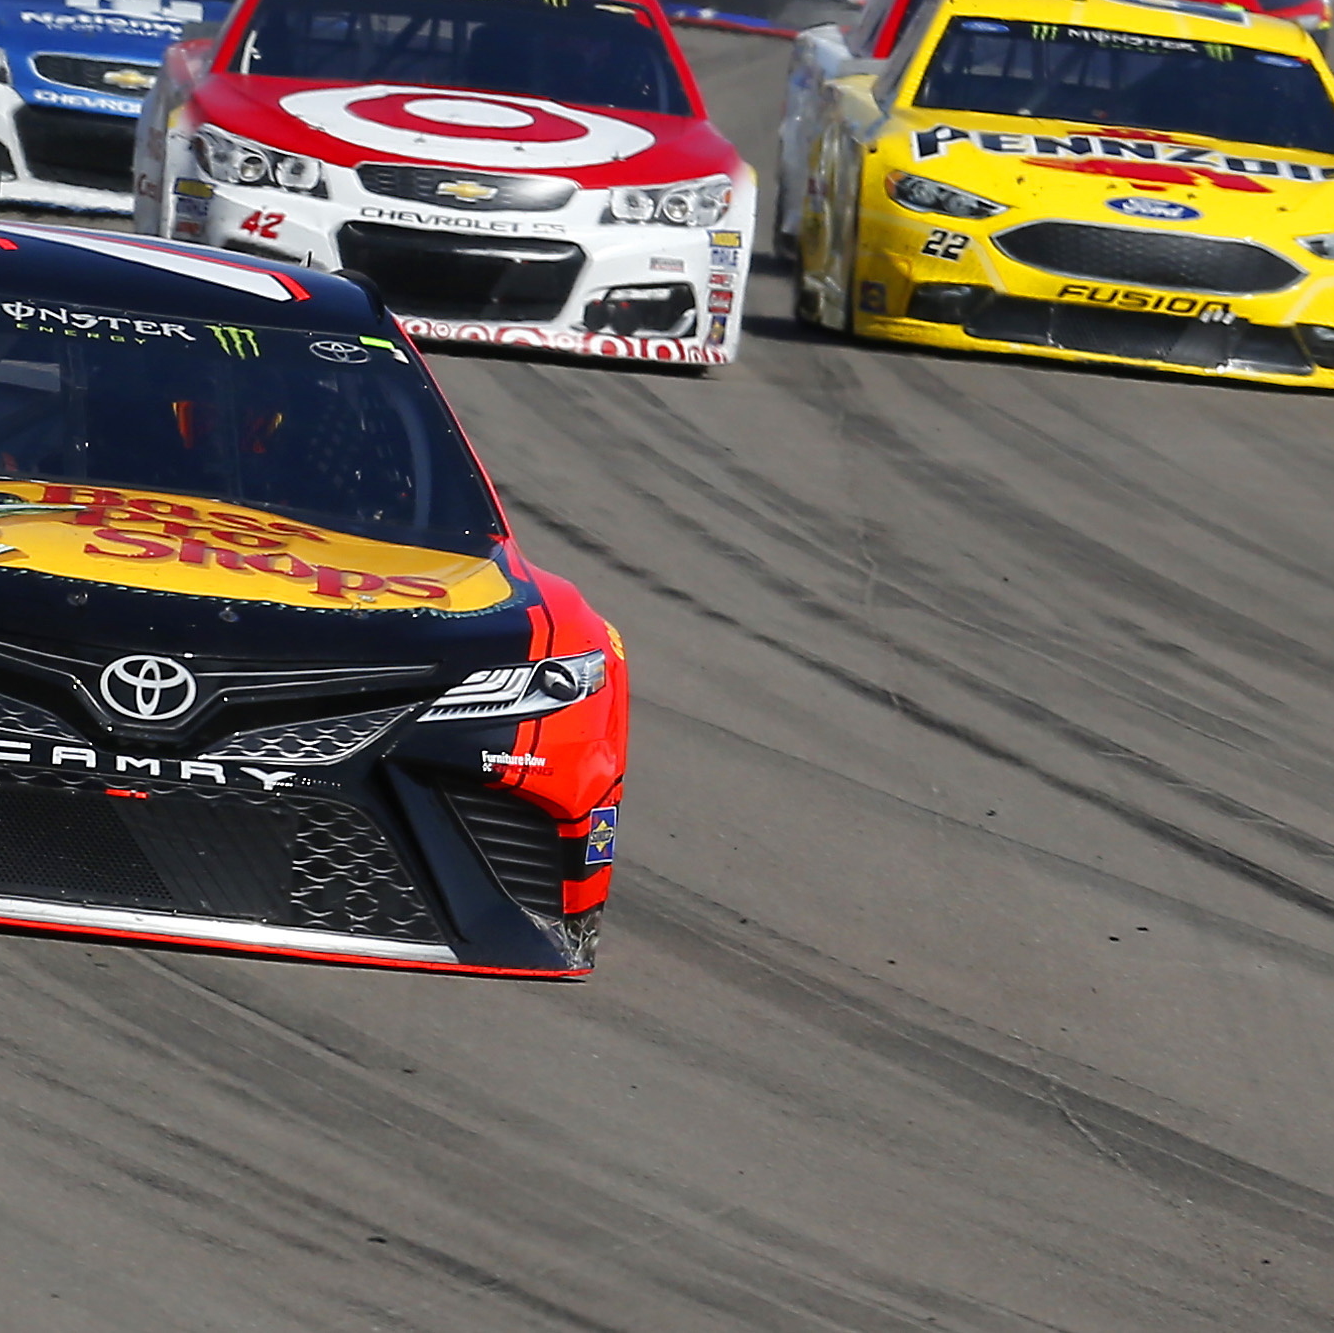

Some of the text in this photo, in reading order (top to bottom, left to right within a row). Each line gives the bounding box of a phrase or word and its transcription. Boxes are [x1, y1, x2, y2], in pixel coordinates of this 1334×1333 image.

[1068, 27, 1198, 53] MONSTER
[359, 205, 523, 233] CHEVROLET
[1123, 198, 1186, 219] Ford
[240, 210, 286, 240] 42
[919, 229, 969, 261] 22
[1057, 285, 1234, 316] FUSION
[15, 322, 147, 345] ENERGY
[43, 485, 329, 544] Bass
[72, 504, 289, 549] Pro
[83, 527, 448, 600] Shops
[481, 750, 547, 767] Furniture Row
